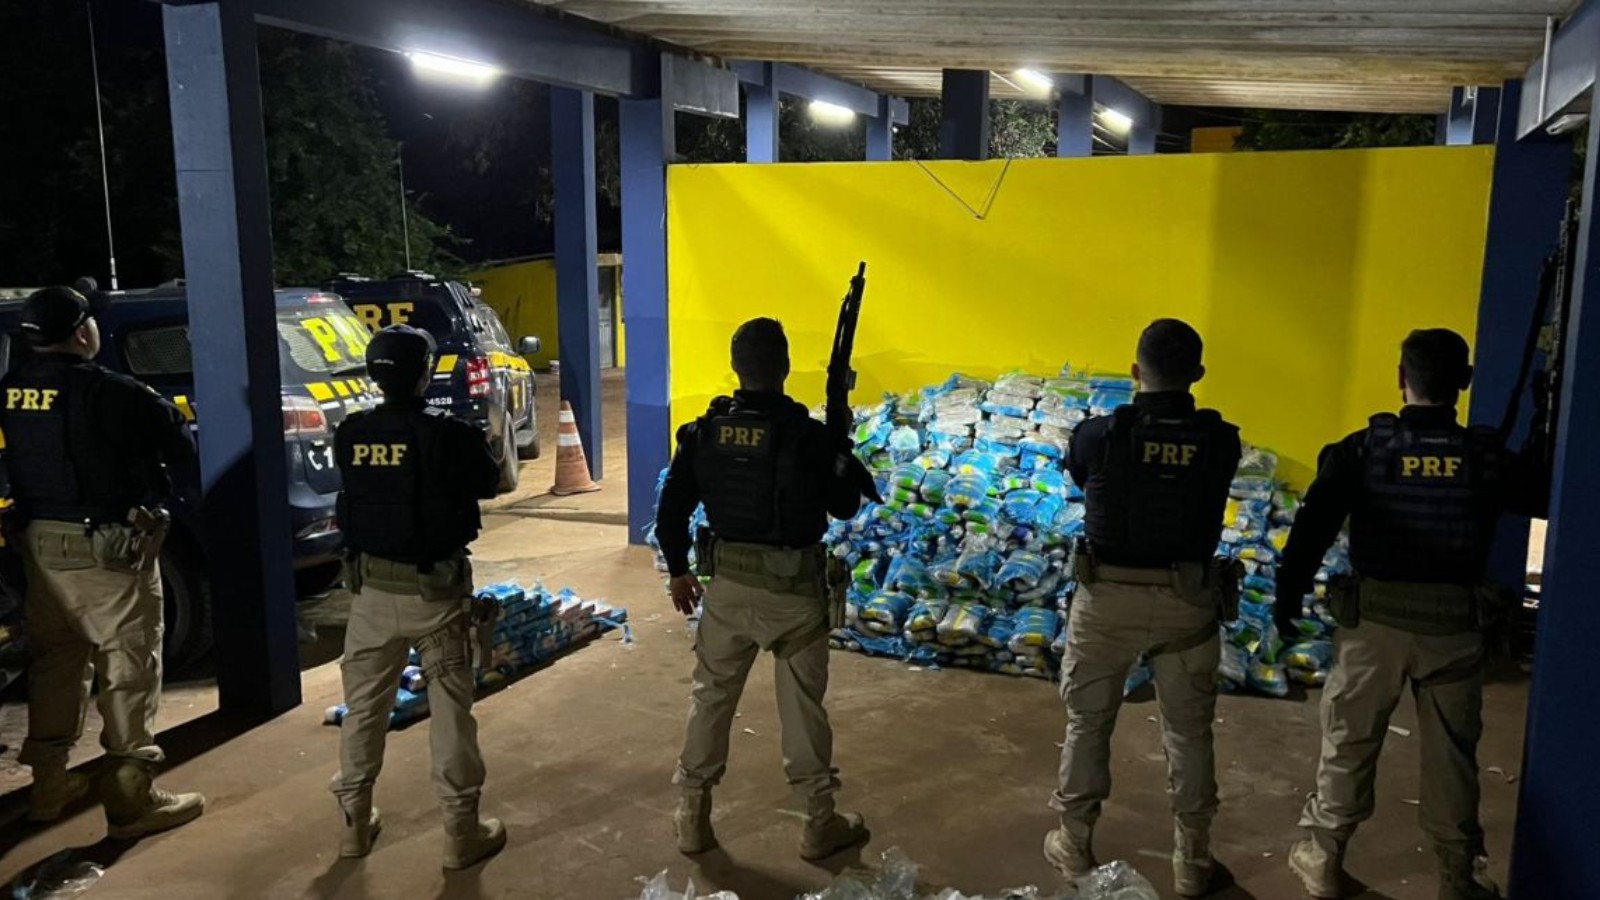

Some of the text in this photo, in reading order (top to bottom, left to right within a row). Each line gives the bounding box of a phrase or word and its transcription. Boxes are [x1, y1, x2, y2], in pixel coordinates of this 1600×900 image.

[353, 302, 414, 334] RF
[5, 387, 59, 410] PRF
[720, 425, 766, 447] PRF
[352, 443, 408, 466] PRF
[1142, 441, 1197, 466] PRF
[1401, 456, 1462, 477] PRF
